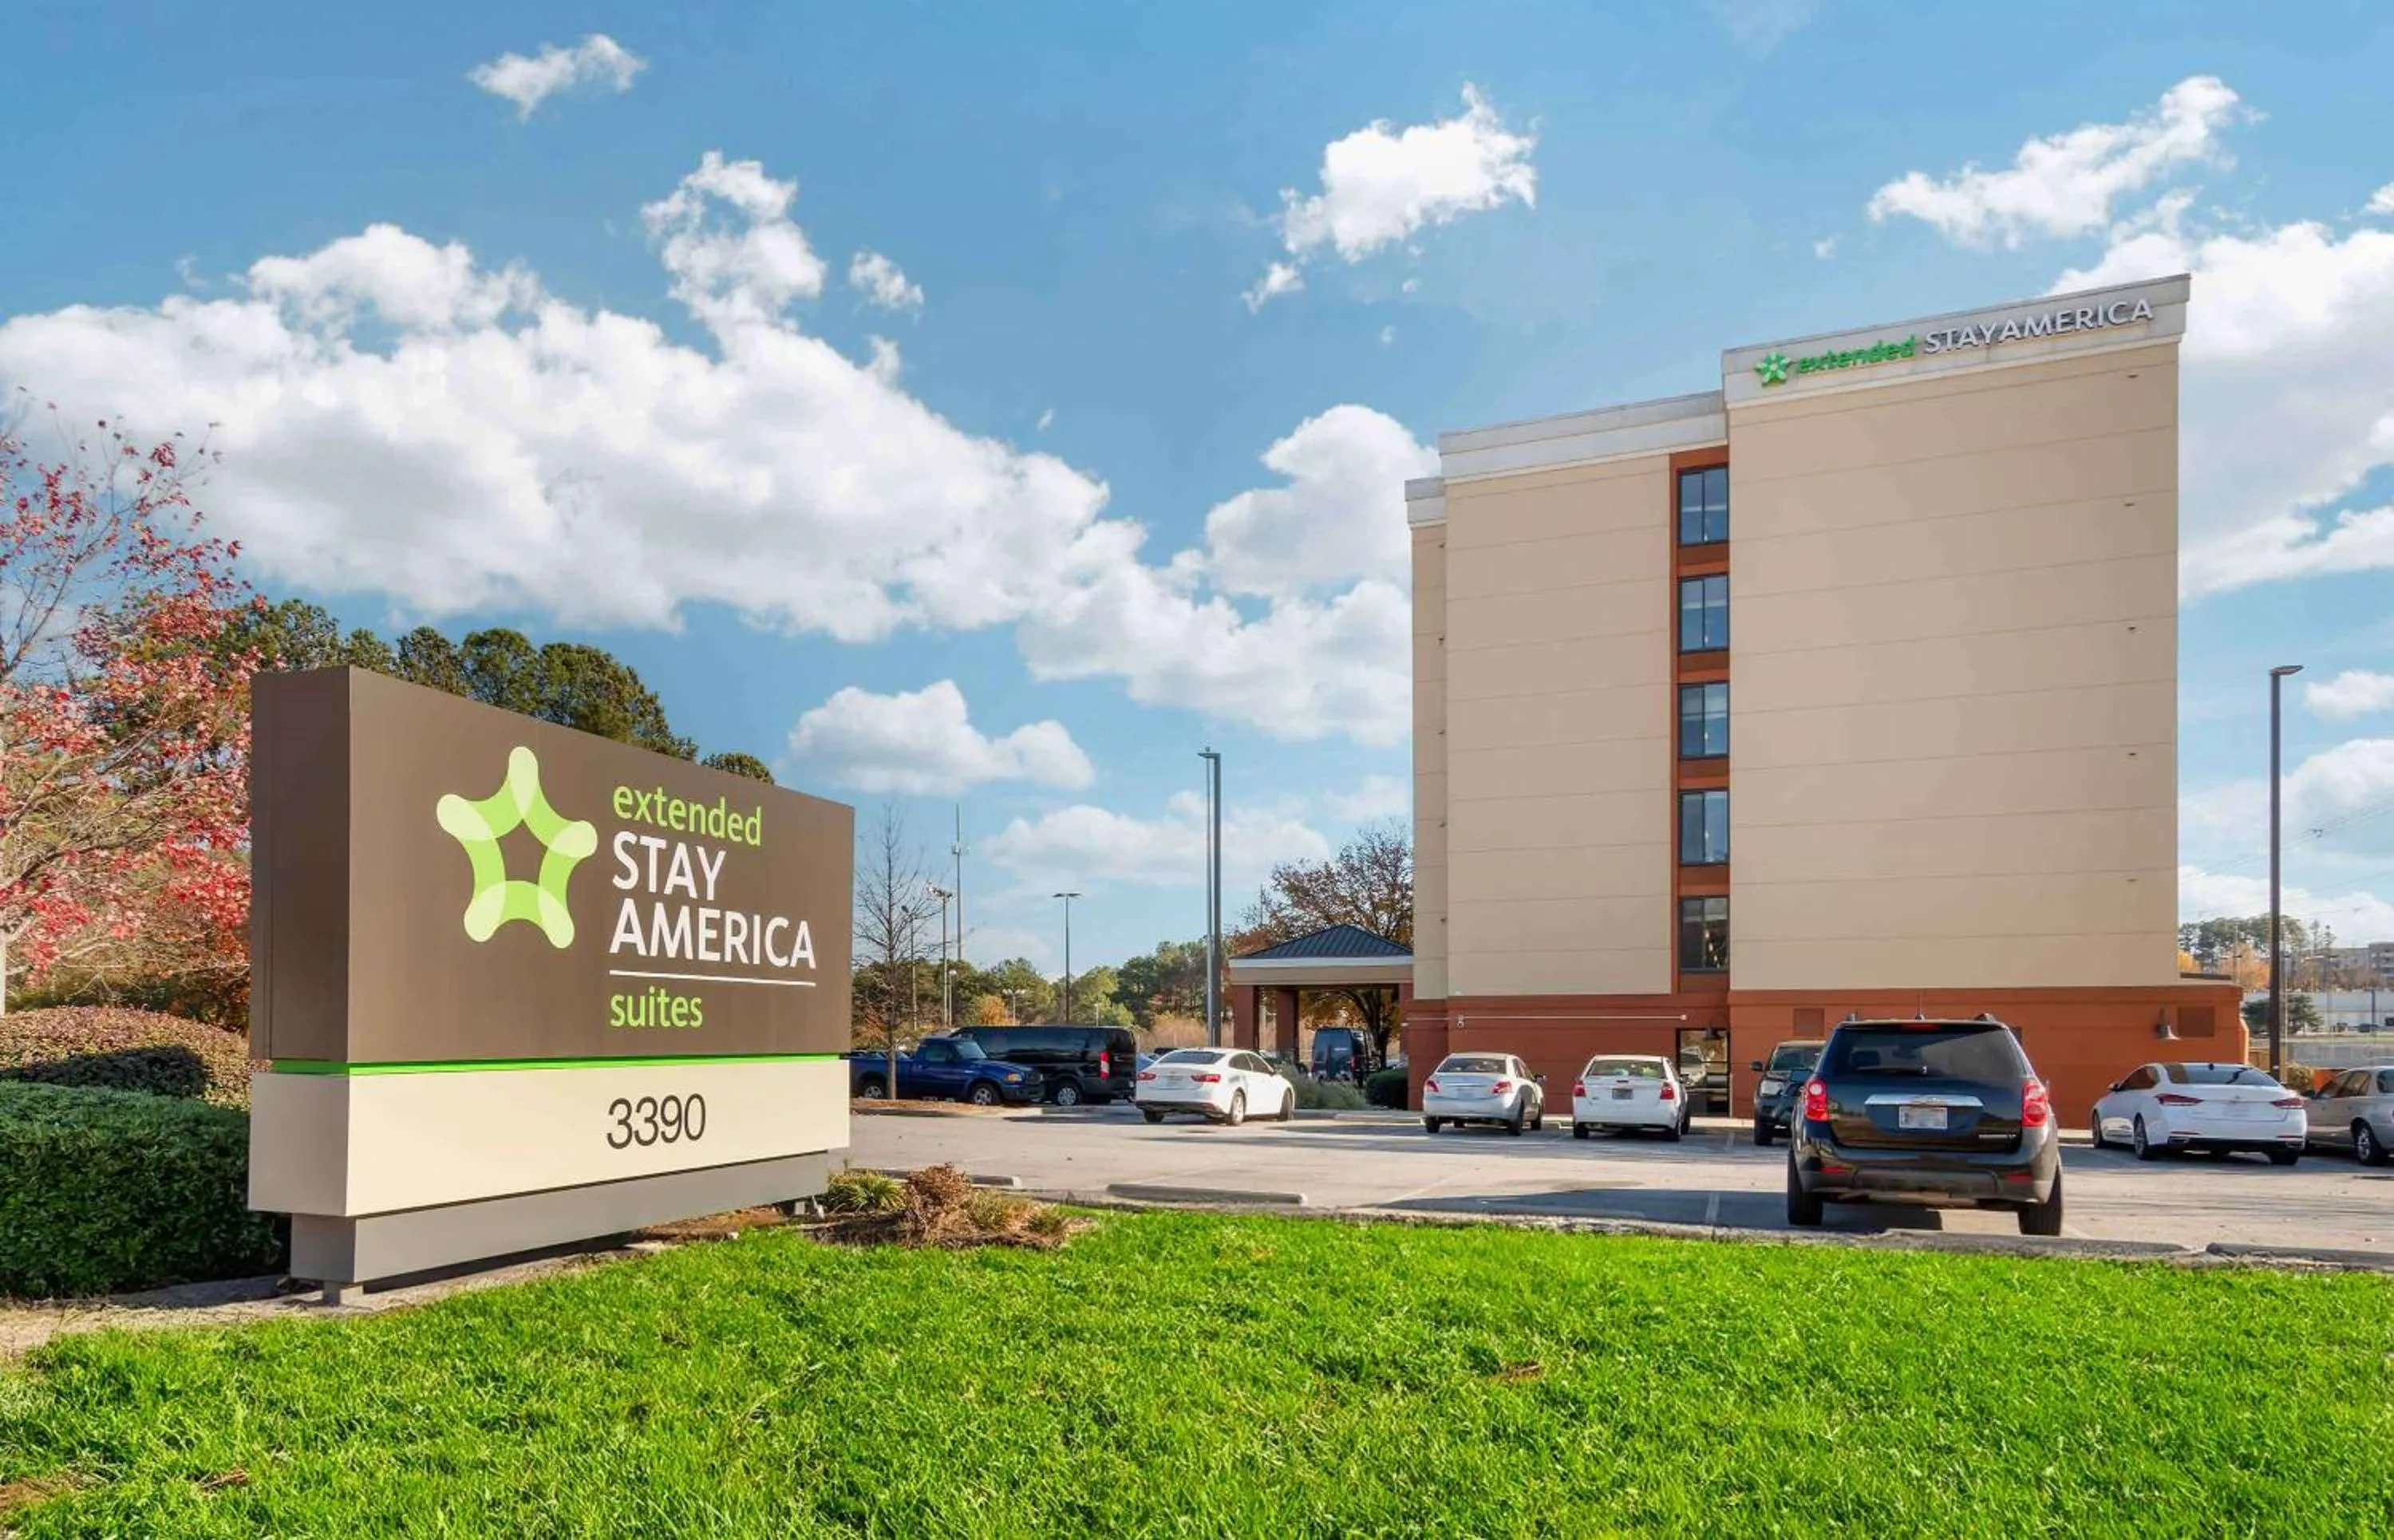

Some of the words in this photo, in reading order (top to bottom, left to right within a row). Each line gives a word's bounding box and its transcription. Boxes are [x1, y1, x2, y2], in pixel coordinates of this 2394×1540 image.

[1797, 335, 1915, 373] extended
[613, 785, 762, 846] extended
[612, 831, 725, 901] STAY
[610, 898, 816, 969] AMERICA
[610, 986, 702, 1027] suites
[607, 1093, 706, 1149] 3390
